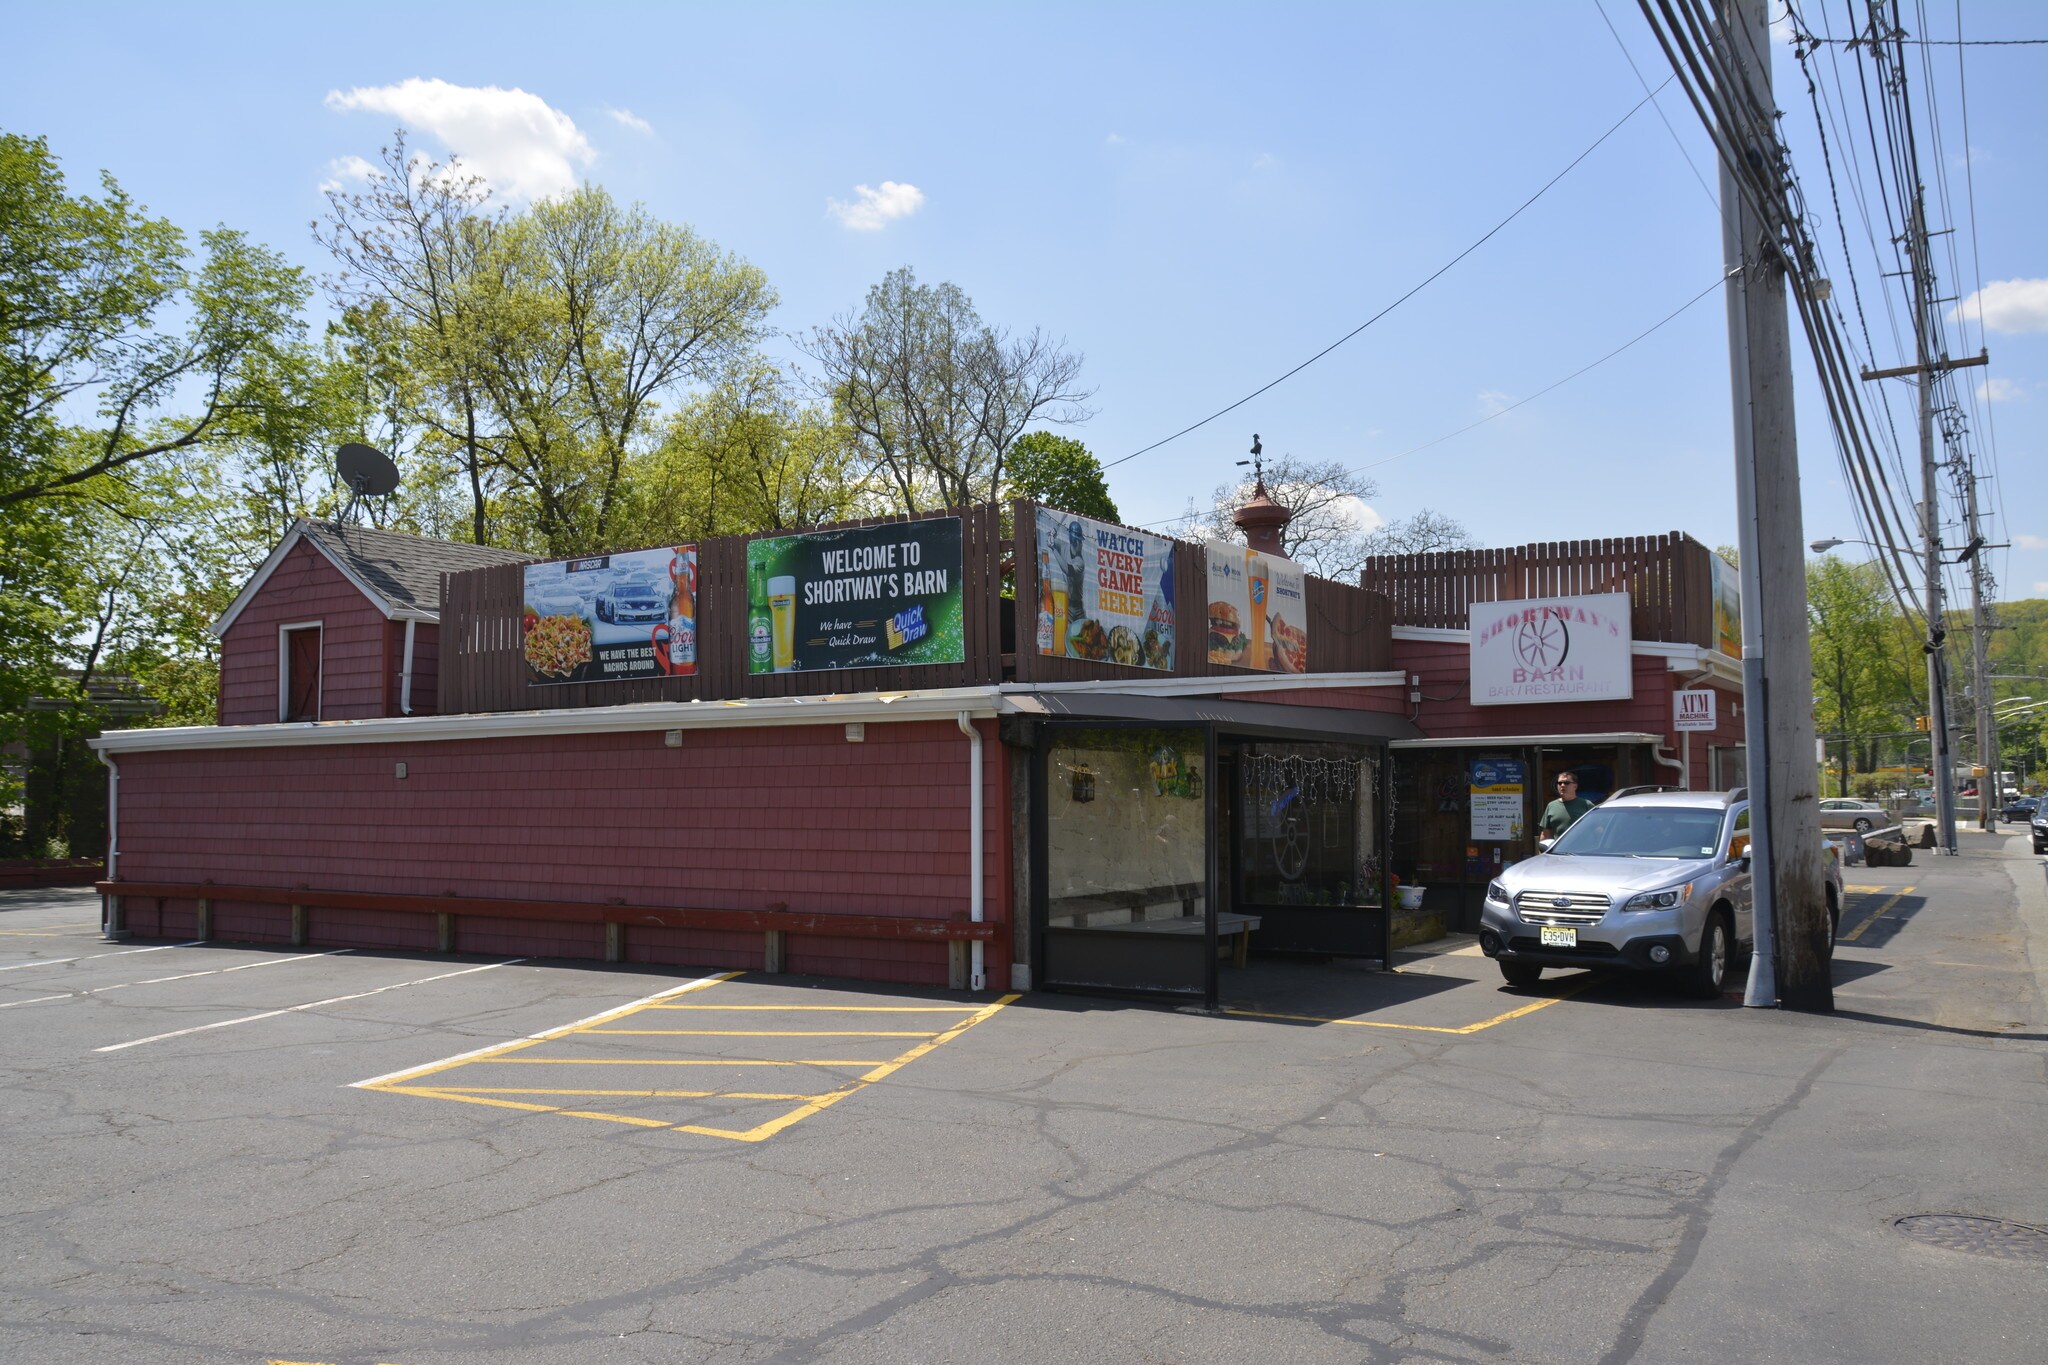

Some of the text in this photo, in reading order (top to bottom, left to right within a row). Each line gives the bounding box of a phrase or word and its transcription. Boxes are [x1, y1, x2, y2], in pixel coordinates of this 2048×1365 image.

[1096, 529, 1144, 556] WATCH
[580, 559, 603, 570] NASCAR
[822, 541, 921, 575] WELCOME TO
[1097, 548, 1144, 574] EVERY
[804, 569, 948, 606] SHORTWAY'S BARN
[1098, 568, 1143, 595] GAME
[1098, 589, 1144, 616] HERE!
[820, 619, 852, 631] We have
[893, 604, 923, 632] Quick
[828, 634, 876, 647] Quick Draw
[902, 621, 928, 643] Draw
[600, 646, 656, 660] WE HAVE THE BEST
[672, 644, 692, 654] LIGHT
[604, 660, 654, 673] NACHOS AROUND
[1512, 665, 1584, 684] BARN
[1488, 686, 1514, 698] BAR
[1526, 680, 1612, 696] RESTAURANT
[1680, 694, 1709, 714] ATM
[1680, 712, 1710, 720] MACHINE
